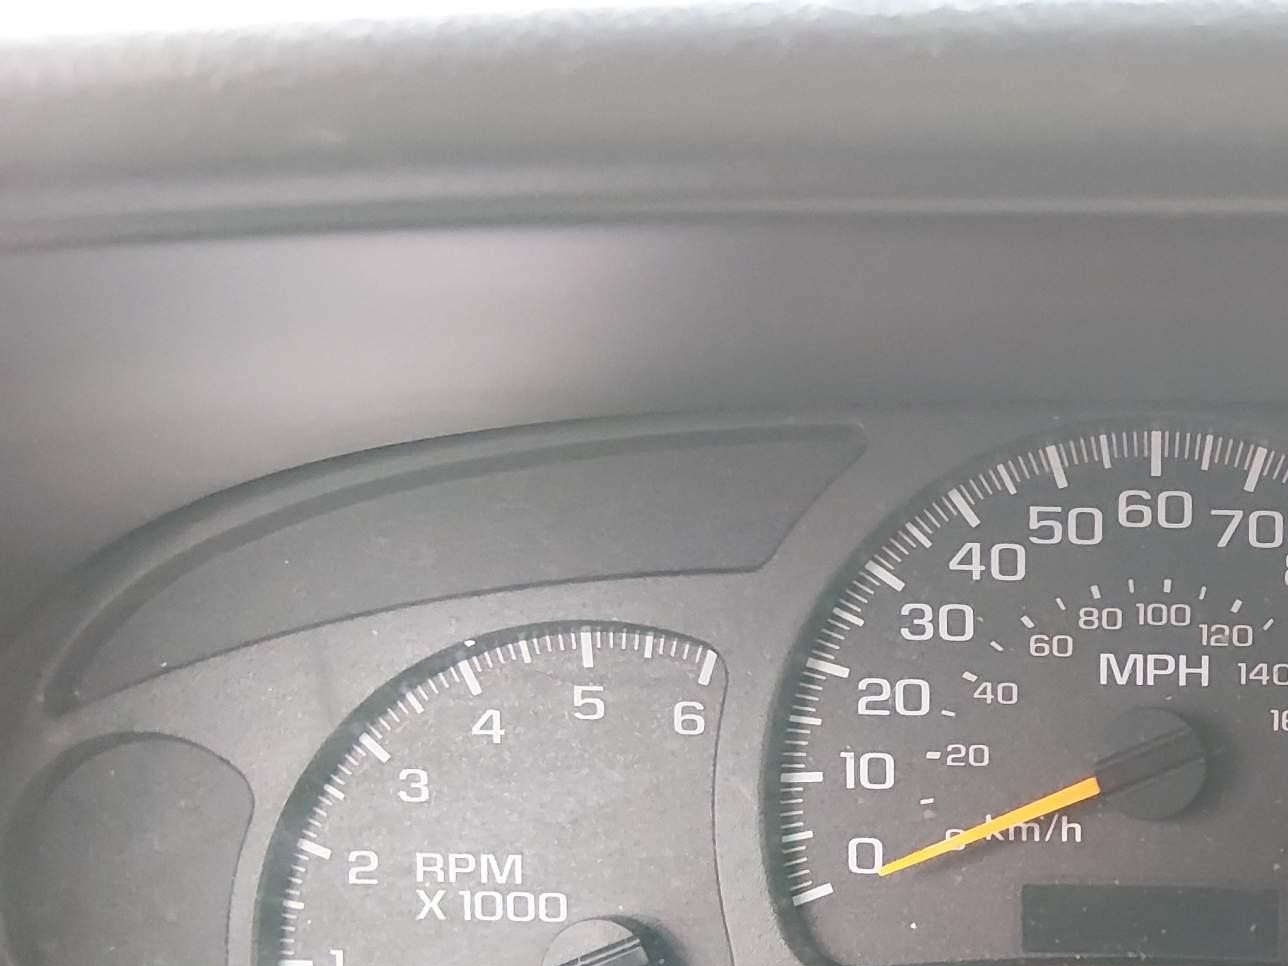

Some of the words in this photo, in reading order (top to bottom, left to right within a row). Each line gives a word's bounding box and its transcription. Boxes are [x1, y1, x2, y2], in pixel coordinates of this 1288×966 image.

[1028, 506, 1103, 545] 50
[1117, 490, 1192, 528] 60
[1210, 509, 1284, 548] 70
[949, 542, 1026, 581] 40
[900, 603, 974, 641] 30
[1078, 607, 1123, 630] 80
[1136, 603, 1191, 626] 100
[1029, 634, 1073, 657] 60
[1199, 624, 1253, 647] 120
[1099, 653, 1209, 687] MPH
[573, 685, 605, 720] 5
[857, 678, 931, 716] 20
[973, 682, 1018, 704] 40
[471, 709, 505, 744] 4
[673, 702, 706, 735] 6
[840, 752, 895, 789] 10
[946, 744, 990, 767] 20
[399, 769, 430, 802] 3
[348, 850, 378, 884] 2
[415, 853, 522, 884] RPM
[848, 837, 883, 874] 0
[415, 890, 445, 920] X
[459, 890, 567, 922] 1000
